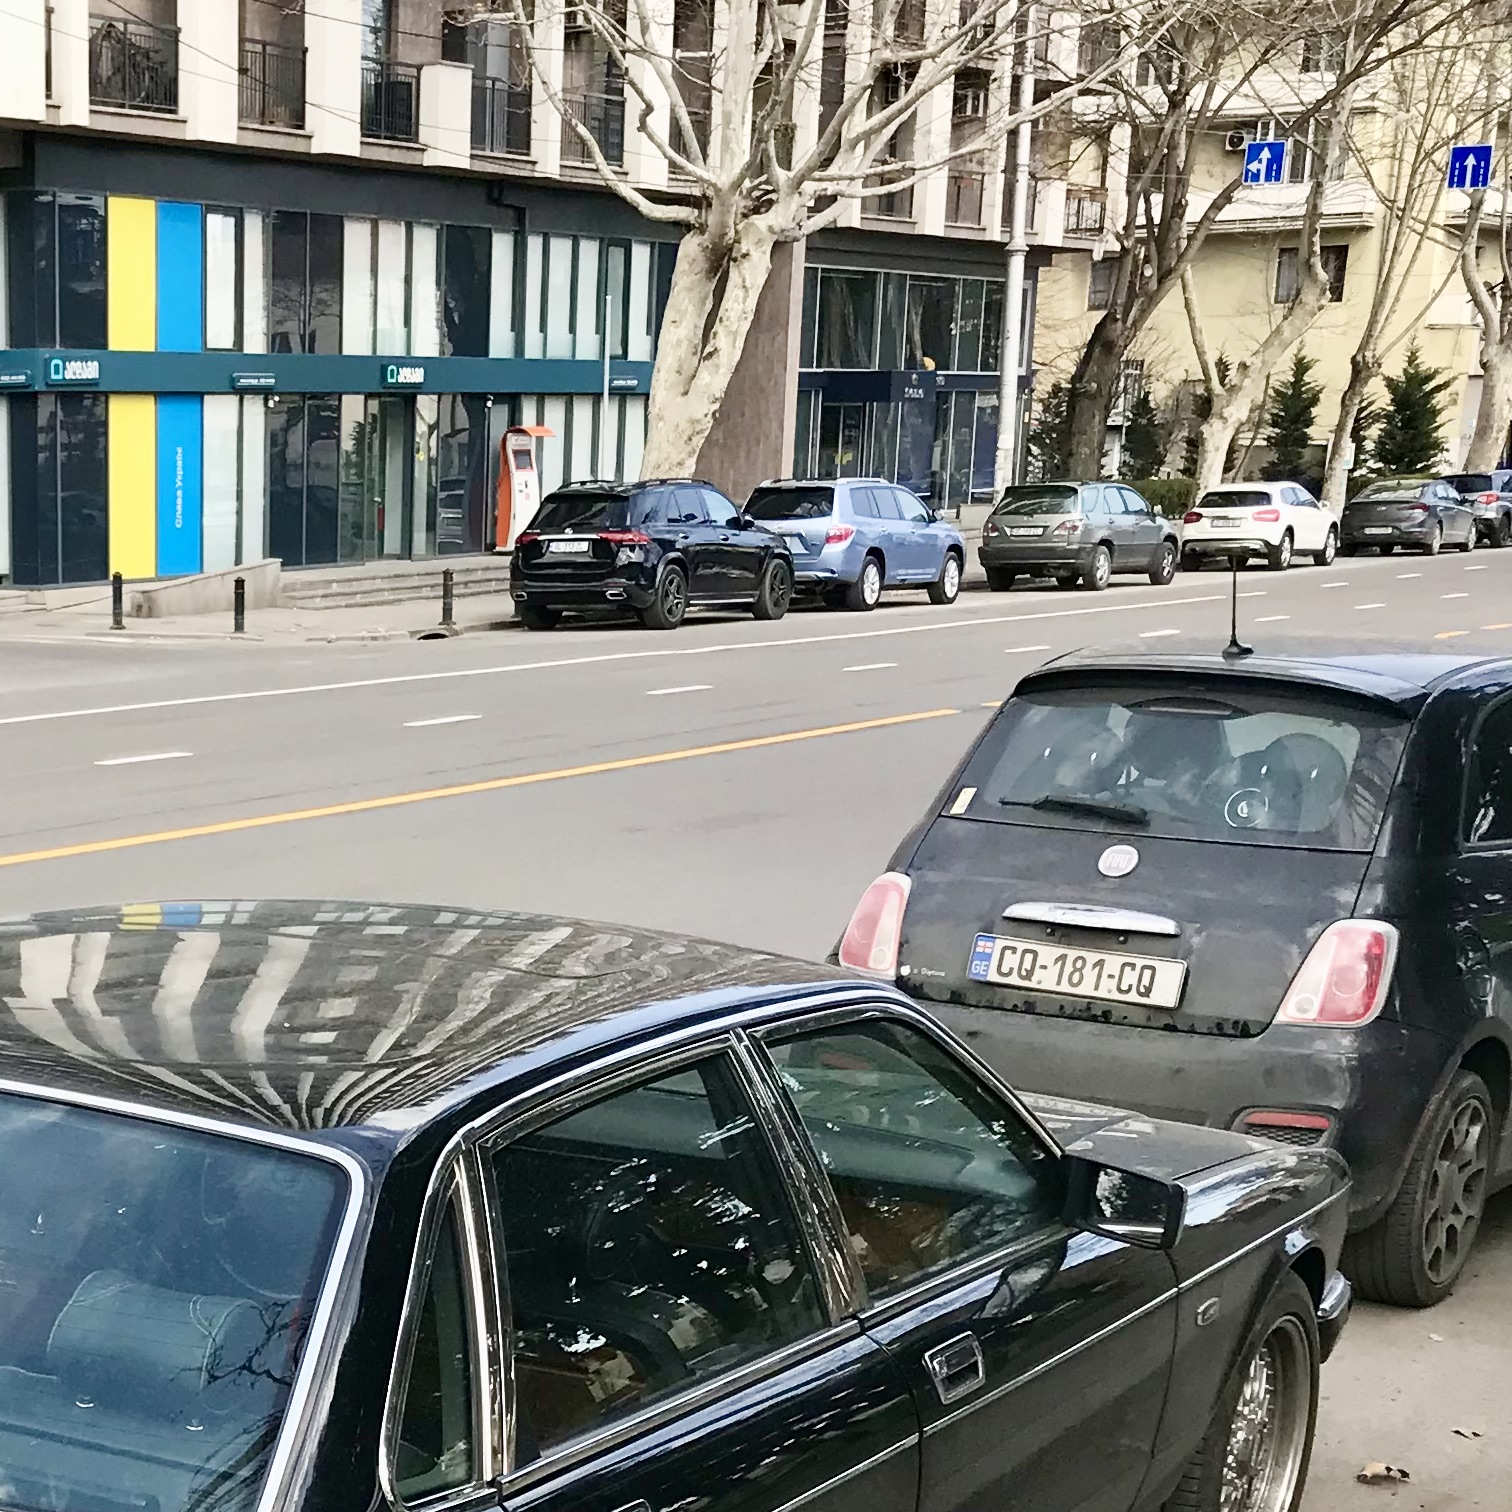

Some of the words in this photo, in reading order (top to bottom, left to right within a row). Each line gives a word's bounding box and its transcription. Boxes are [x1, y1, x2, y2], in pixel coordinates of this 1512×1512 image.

[1105, 852, 1132, 870] FIAT
[971, 959, 988, 976] GE
[996, 945, 1157, 999] CQ-181-CQ
